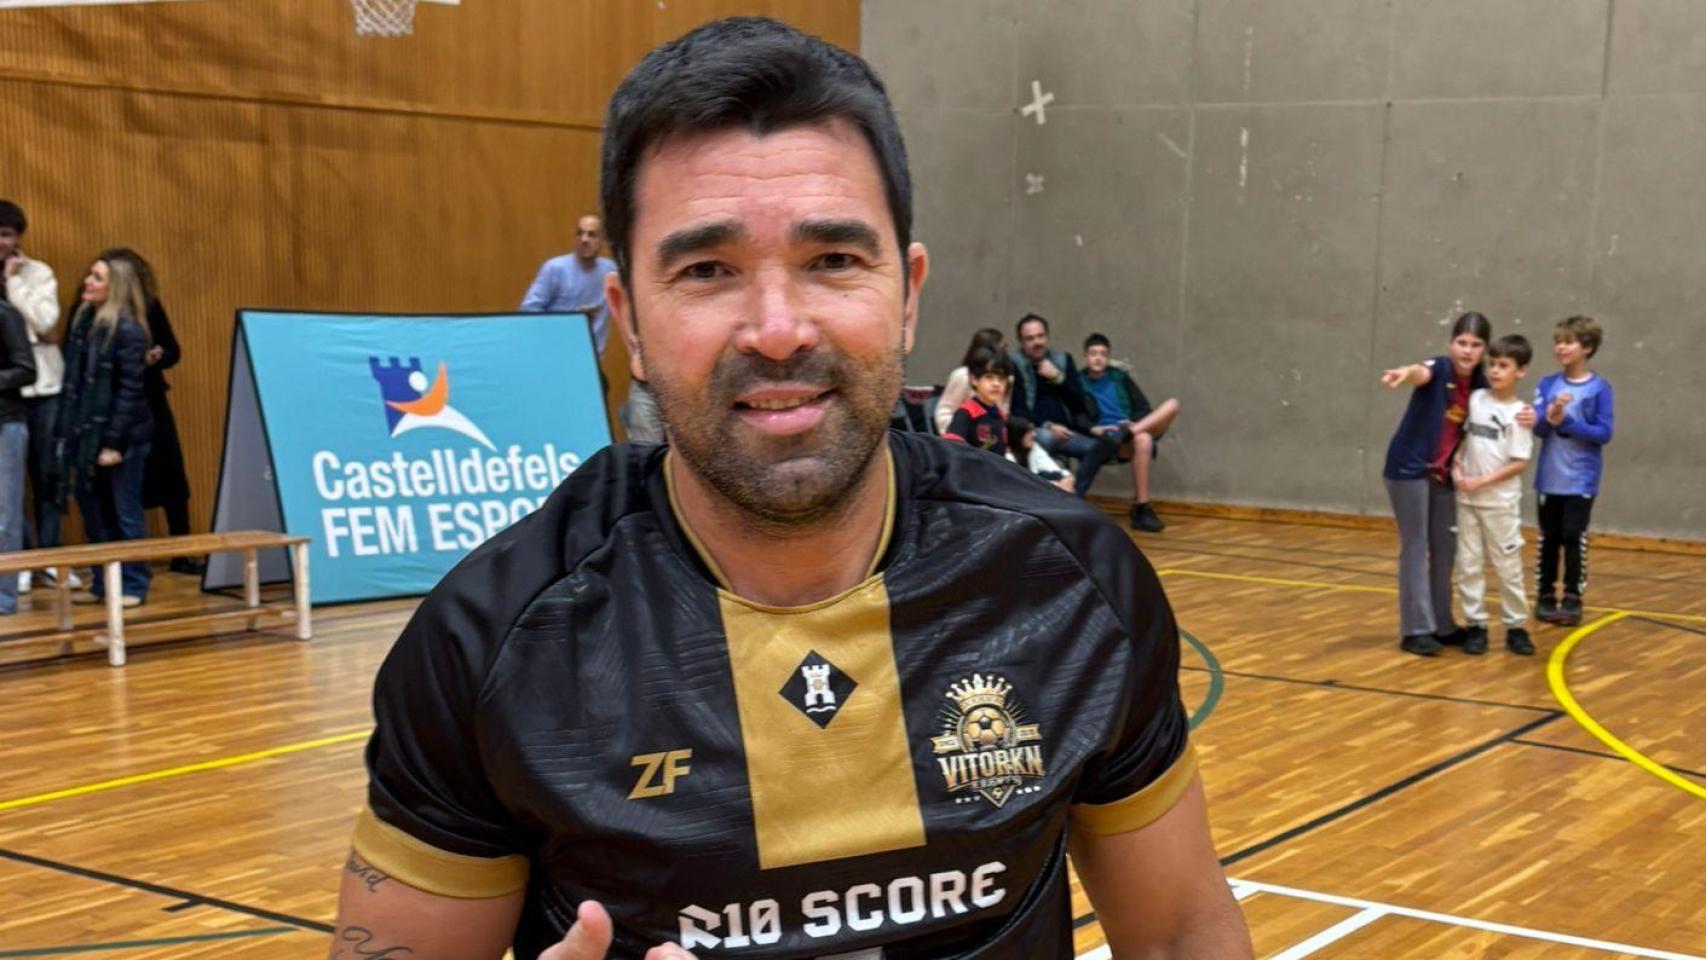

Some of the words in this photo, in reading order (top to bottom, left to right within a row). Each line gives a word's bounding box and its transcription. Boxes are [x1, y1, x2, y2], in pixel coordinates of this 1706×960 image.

[312, 443, 580, 500] Castelldefels
[321, 504, 419, 558] FEM
[428, 496, 547, 552] ESP
[626, 748, 693, 800] ZF
[937, 745, 1045, 789] VITORKN
[677, 898, 783, 950] R10
[801, 861, 1006, 938] SCORE
